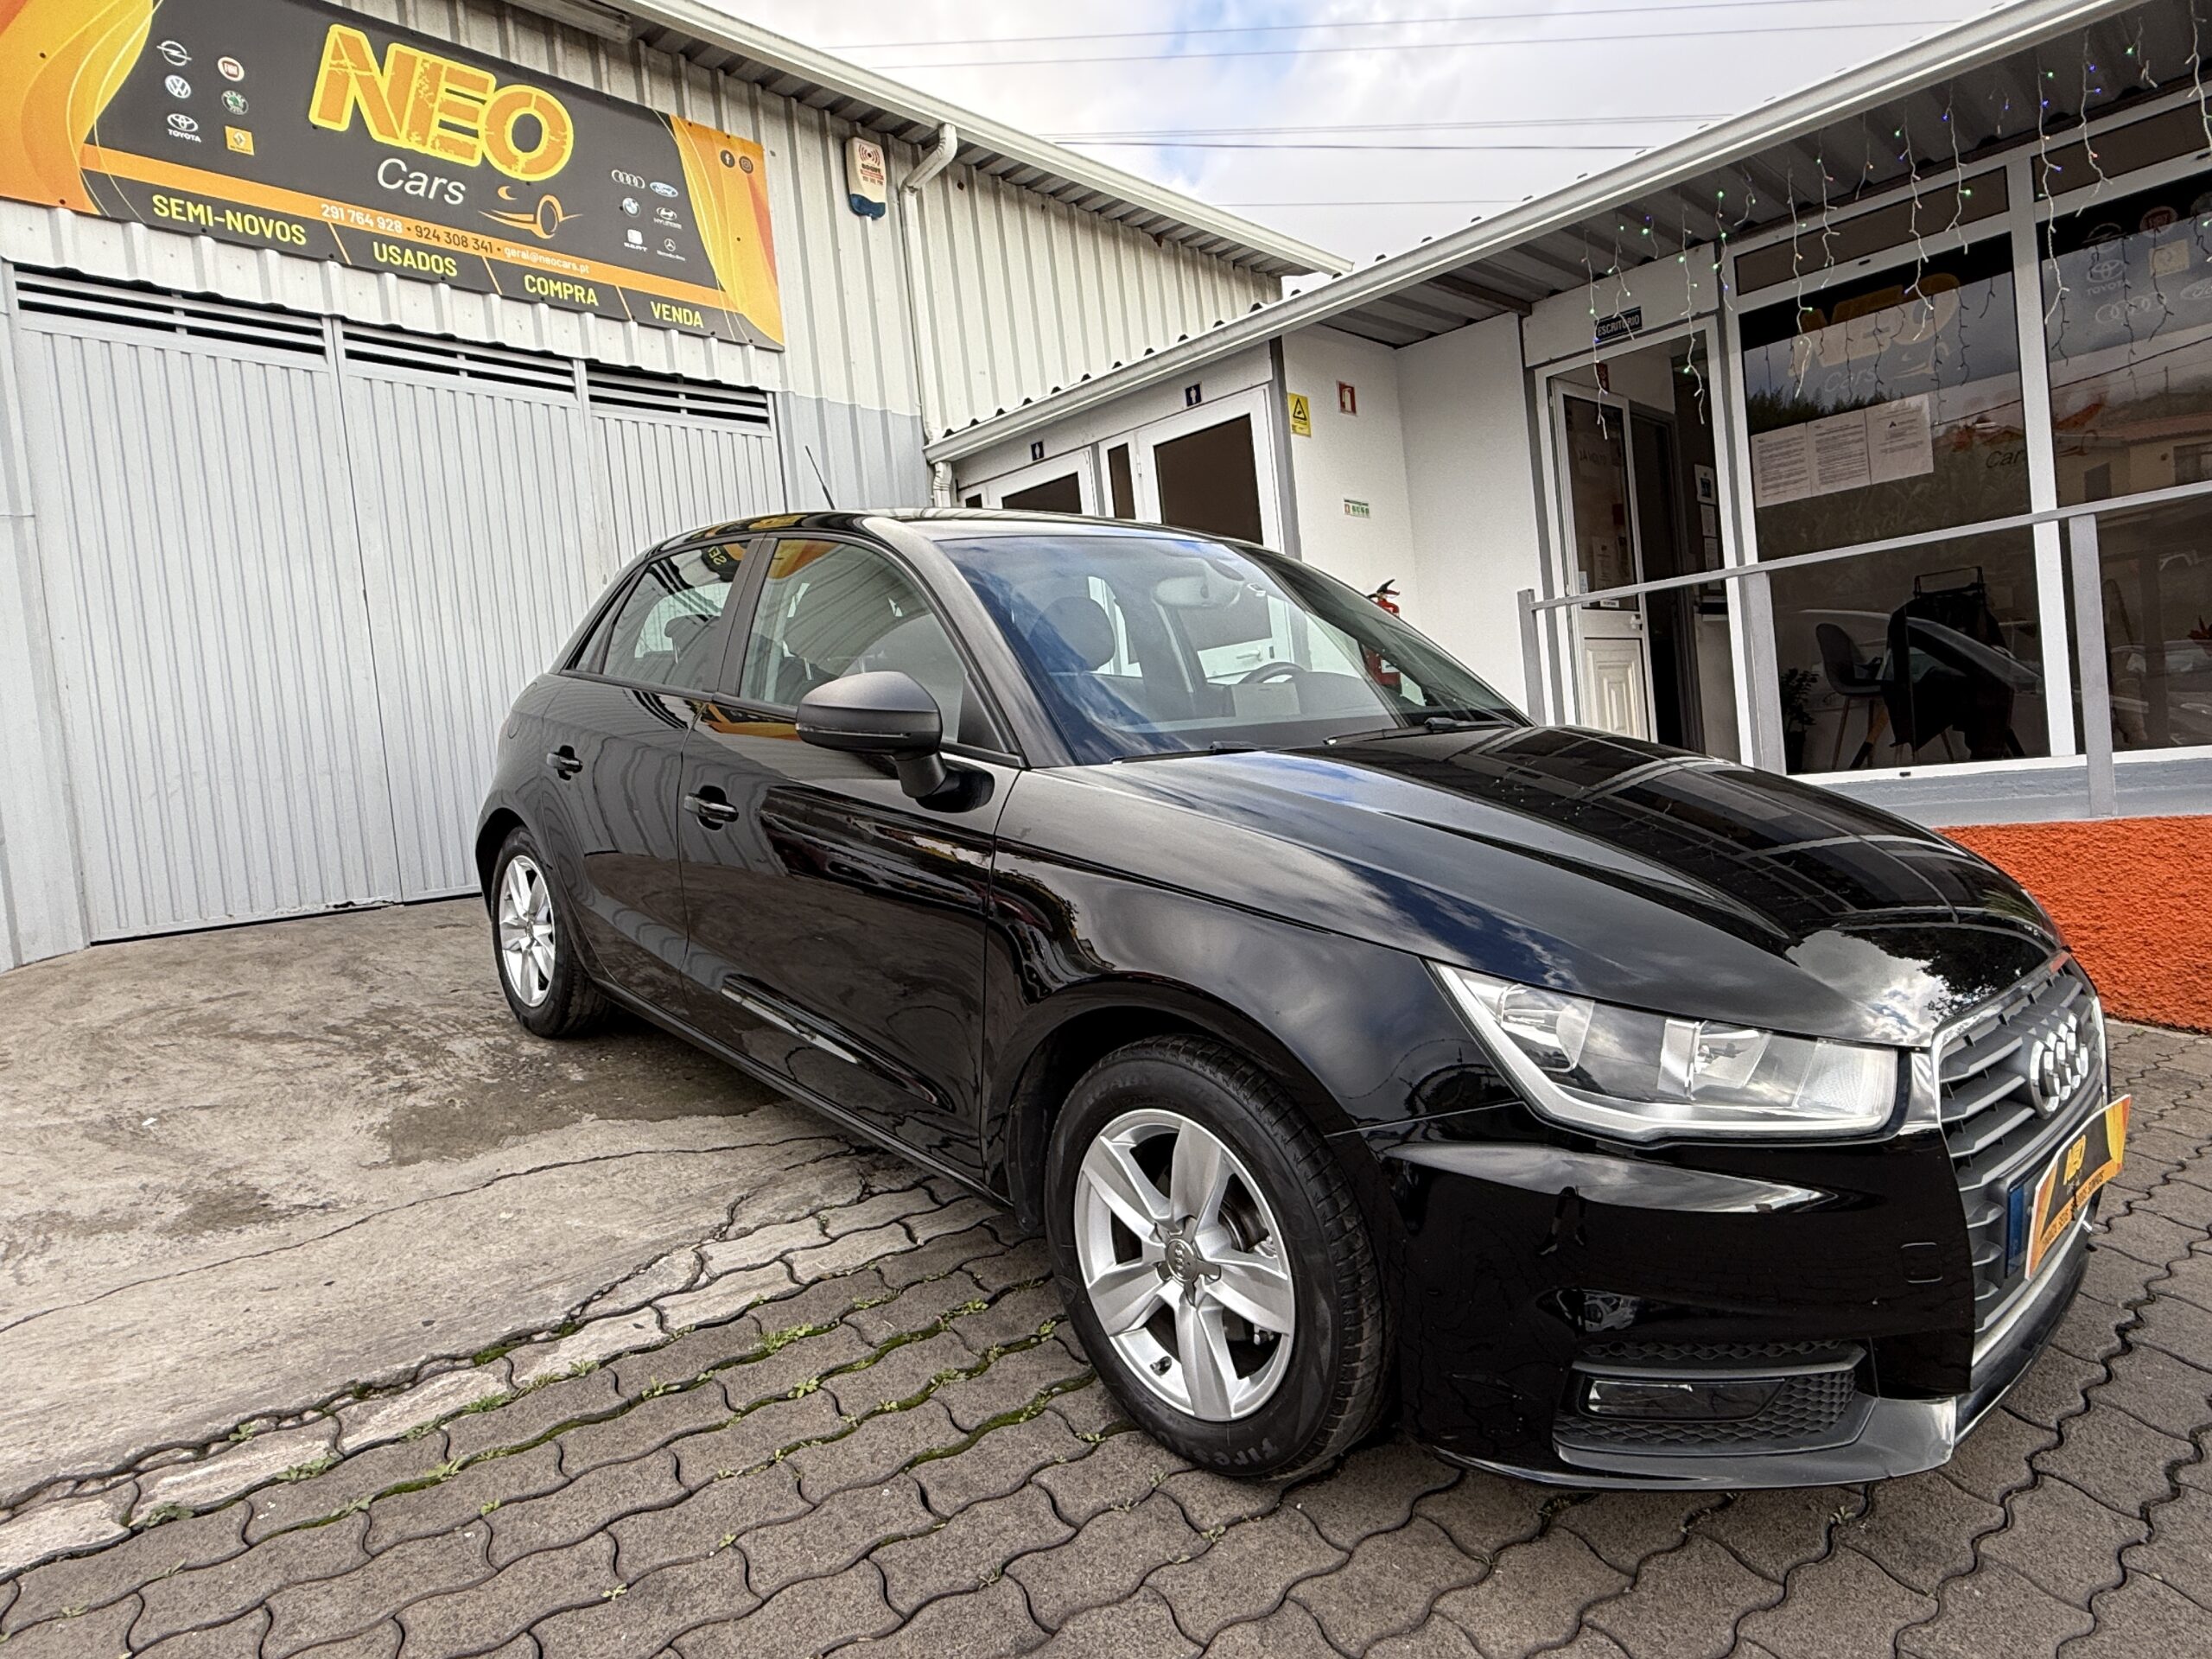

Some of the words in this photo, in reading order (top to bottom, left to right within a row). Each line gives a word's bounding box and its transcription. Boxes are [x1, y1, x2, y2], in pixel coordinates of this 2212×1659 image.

[308, 24, 575, 181] NEO
[168, 128, 202, 143] TOYOTA
[378, 158, 466, 205] Cars
[153, 194, 307, 245] SEMI-NOVOS
[321, 203, 345, 220] 291
[347, 209, 374, 227] 764
[377, 216, 404, 234] 928
[415, 226, 441, 243] 924
[443, 232, 469, 248] 308
[472, 238, 493, 254] 341
[504, 246, 590, 275] geral@neocars.pt
[372, 241, 458, 277] USADOS
[524, 274, 599, 307] COMPRA
[2087, 279, 2132, 296] TOYOTA
[650, 302, 704, 329] VENDA
[1986, 449, 2026, 468] Car
